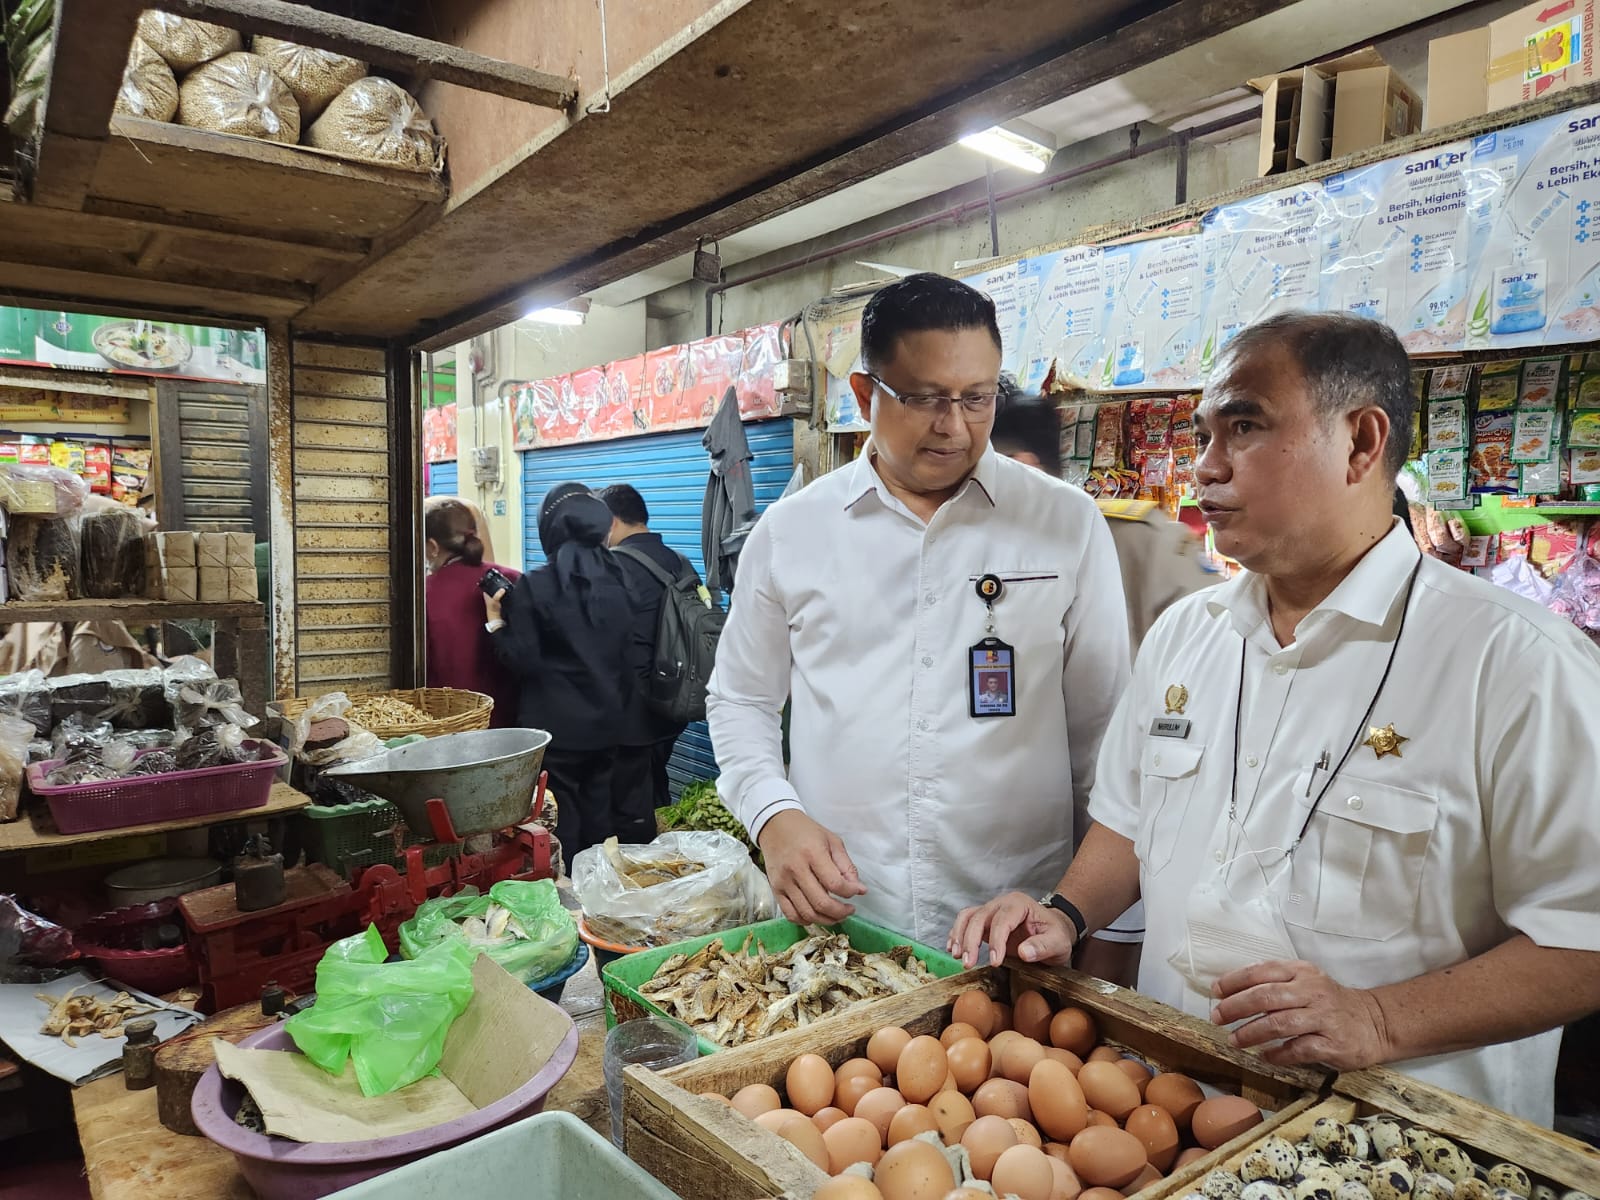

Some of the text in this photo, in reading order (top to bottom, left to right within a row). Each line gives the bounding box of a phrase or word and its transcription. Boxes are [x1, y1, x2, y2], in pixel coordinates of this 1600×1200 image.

[1584, 33, 1594, 77] JANGAN
[1550, 160, 1590, 176] Bersih,
[1537, 181, 1544, 190] &
[1548, 174, 1579, 188] Lebih
[1387, 211, 1413, 223] Lebih
[1416, 200, 1466, 217] Ekonomis
[1389, 189, 1467, 212] Bersih, Higienis
